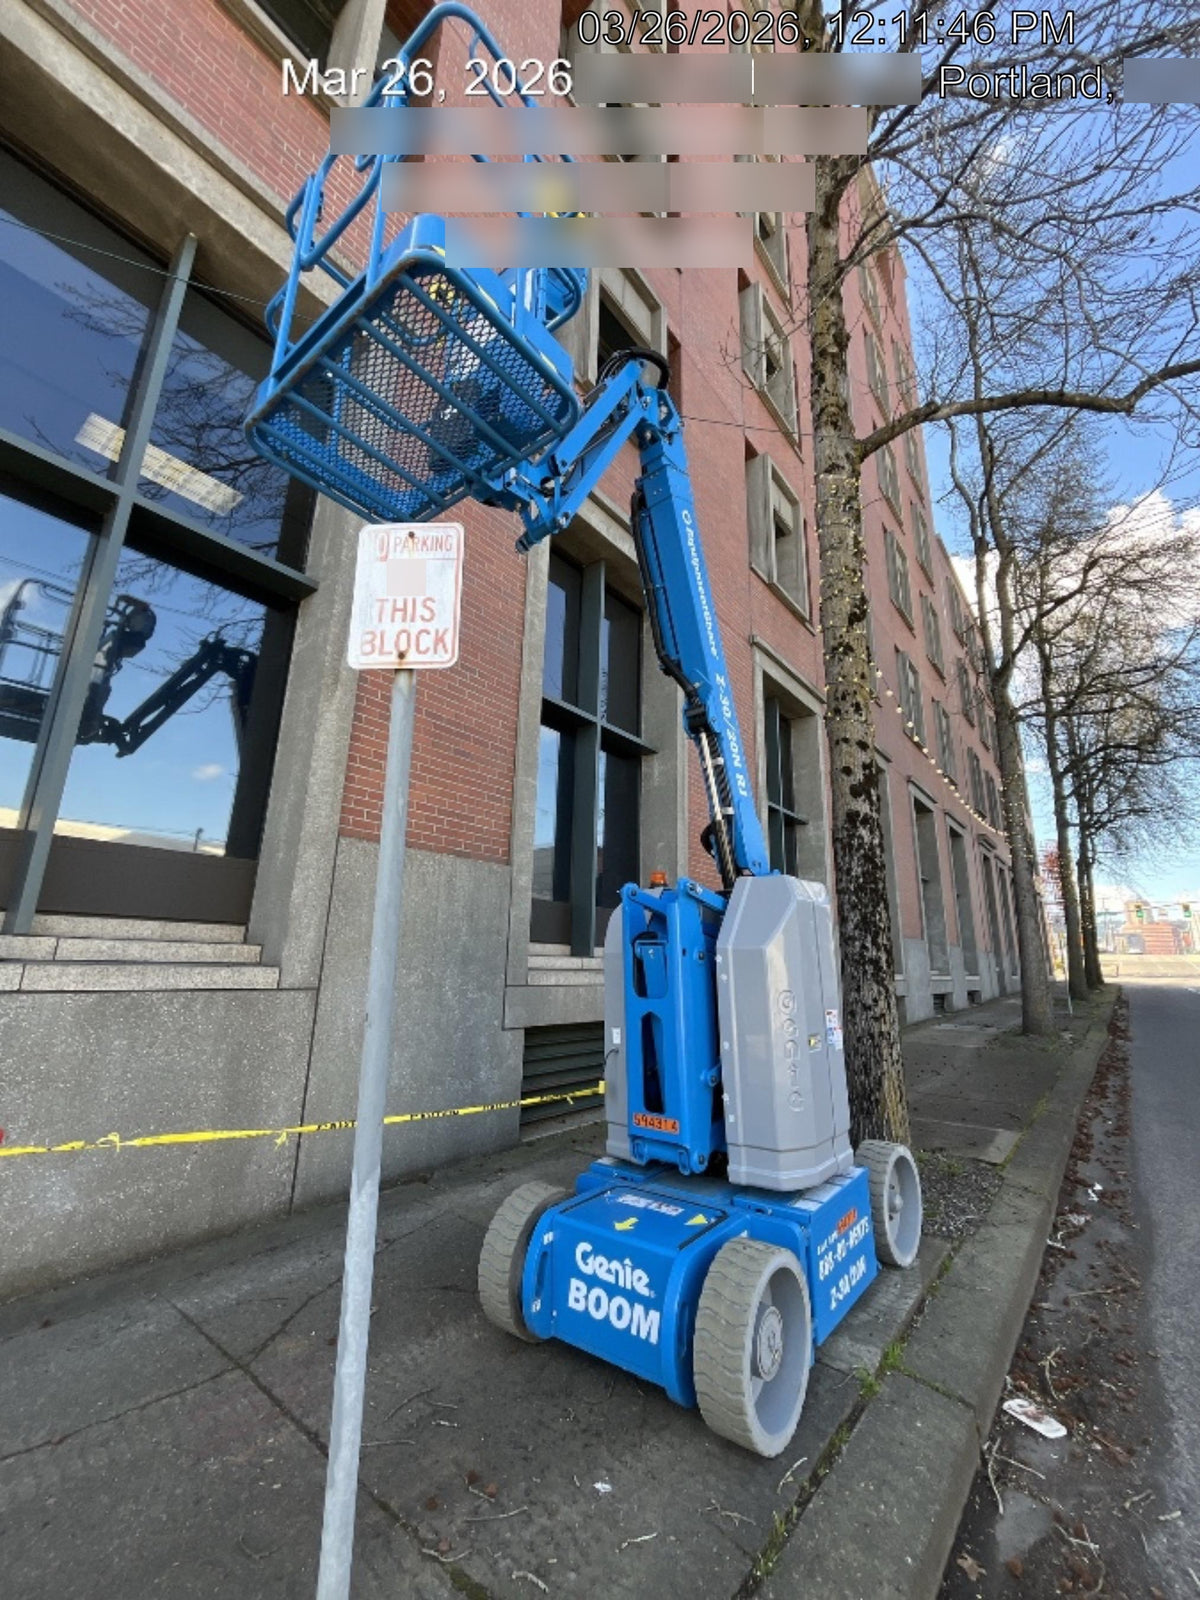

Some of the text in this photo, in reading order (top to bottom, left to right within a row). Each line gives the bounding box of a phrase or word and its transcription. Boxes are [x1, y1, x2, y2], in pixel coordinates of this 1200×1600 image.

[394, 534, 453, 553] PARKING
[376, 597, 436, 623] THIS
[360, 628, 450, 657] BLOCK
[574, 1241, 652, 1298] Genie
[568, 1277, 661, 1345] BOOM
